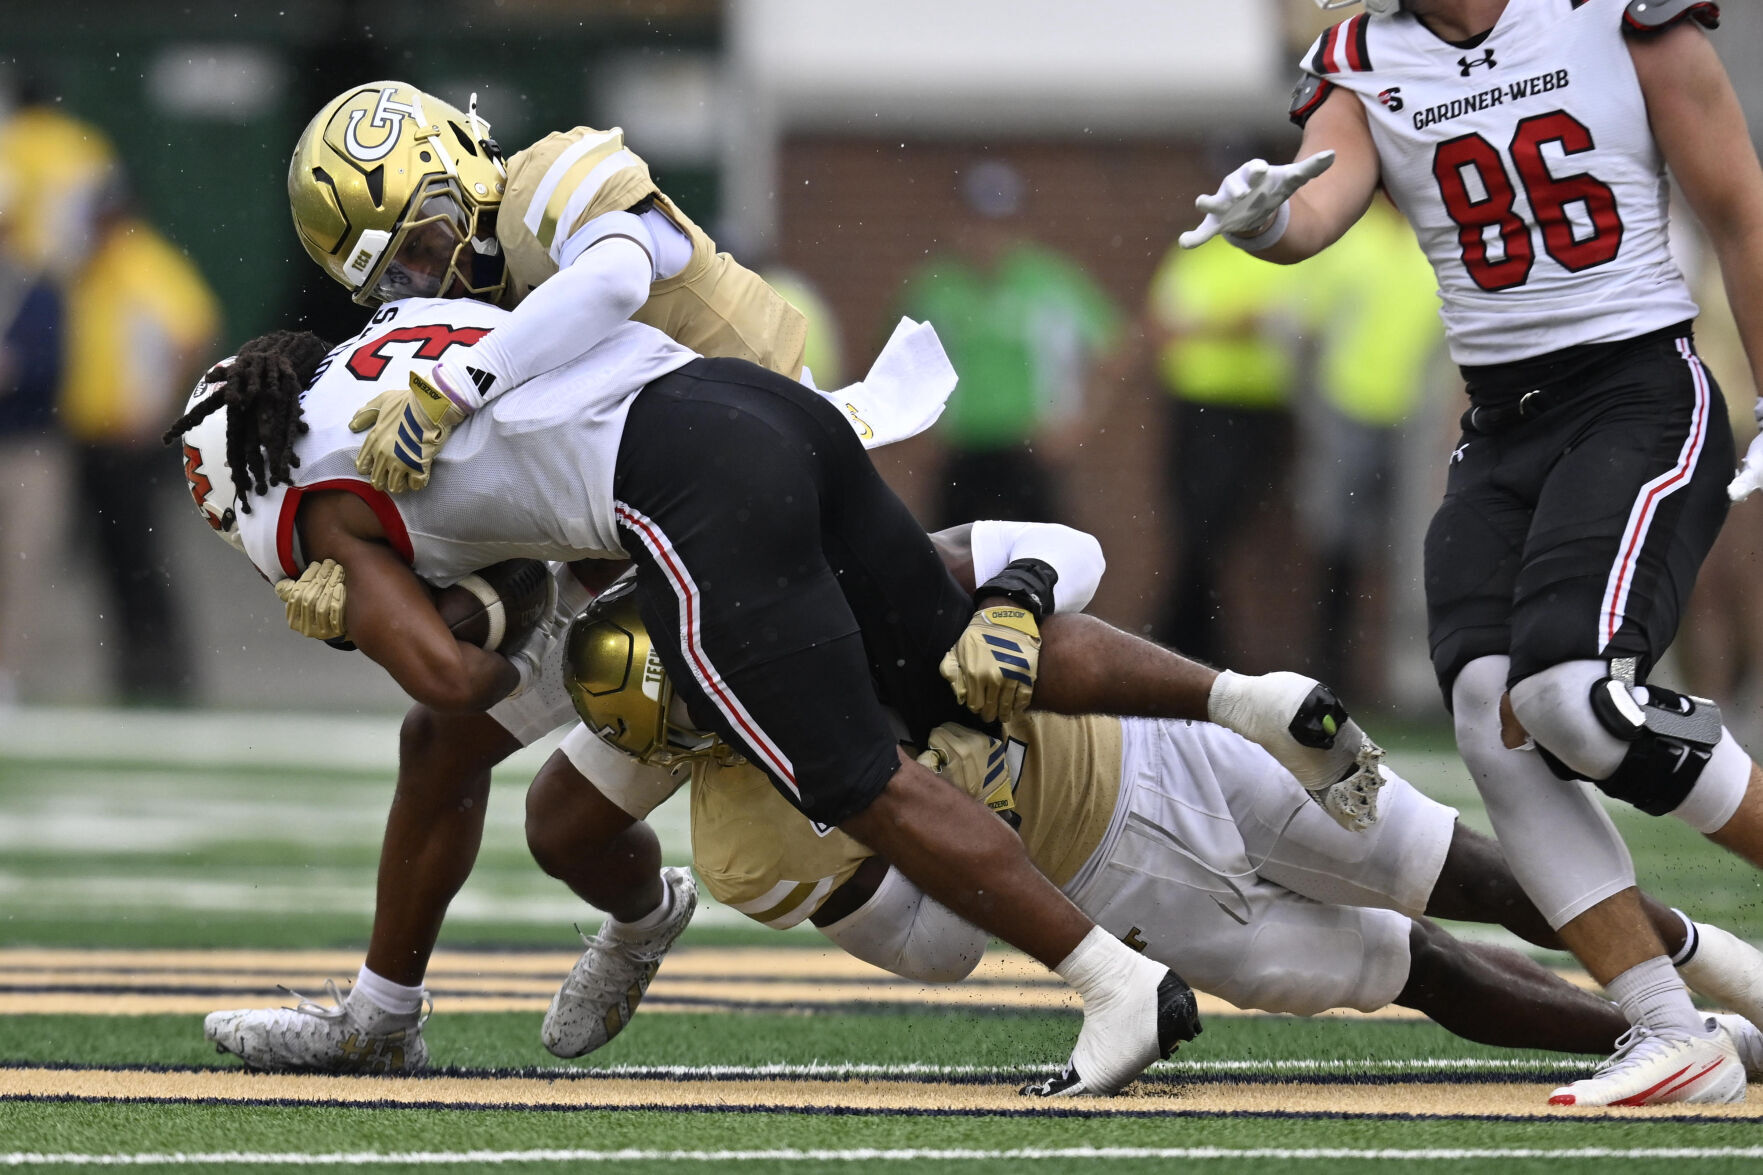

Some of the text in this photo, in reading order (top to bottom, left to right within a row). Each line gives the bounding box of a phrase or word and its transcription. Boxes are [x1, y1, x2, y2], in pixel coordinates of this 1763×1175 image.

[1413, 69, 1569, 131] GARDNER-WEBB
[1432, 109, 1623, 291] 86
[351, 249, 373, 272] TECH
[413, 376, 441, 400] ADIZERO
[992, 610, 1025, 618] ADIZERO
